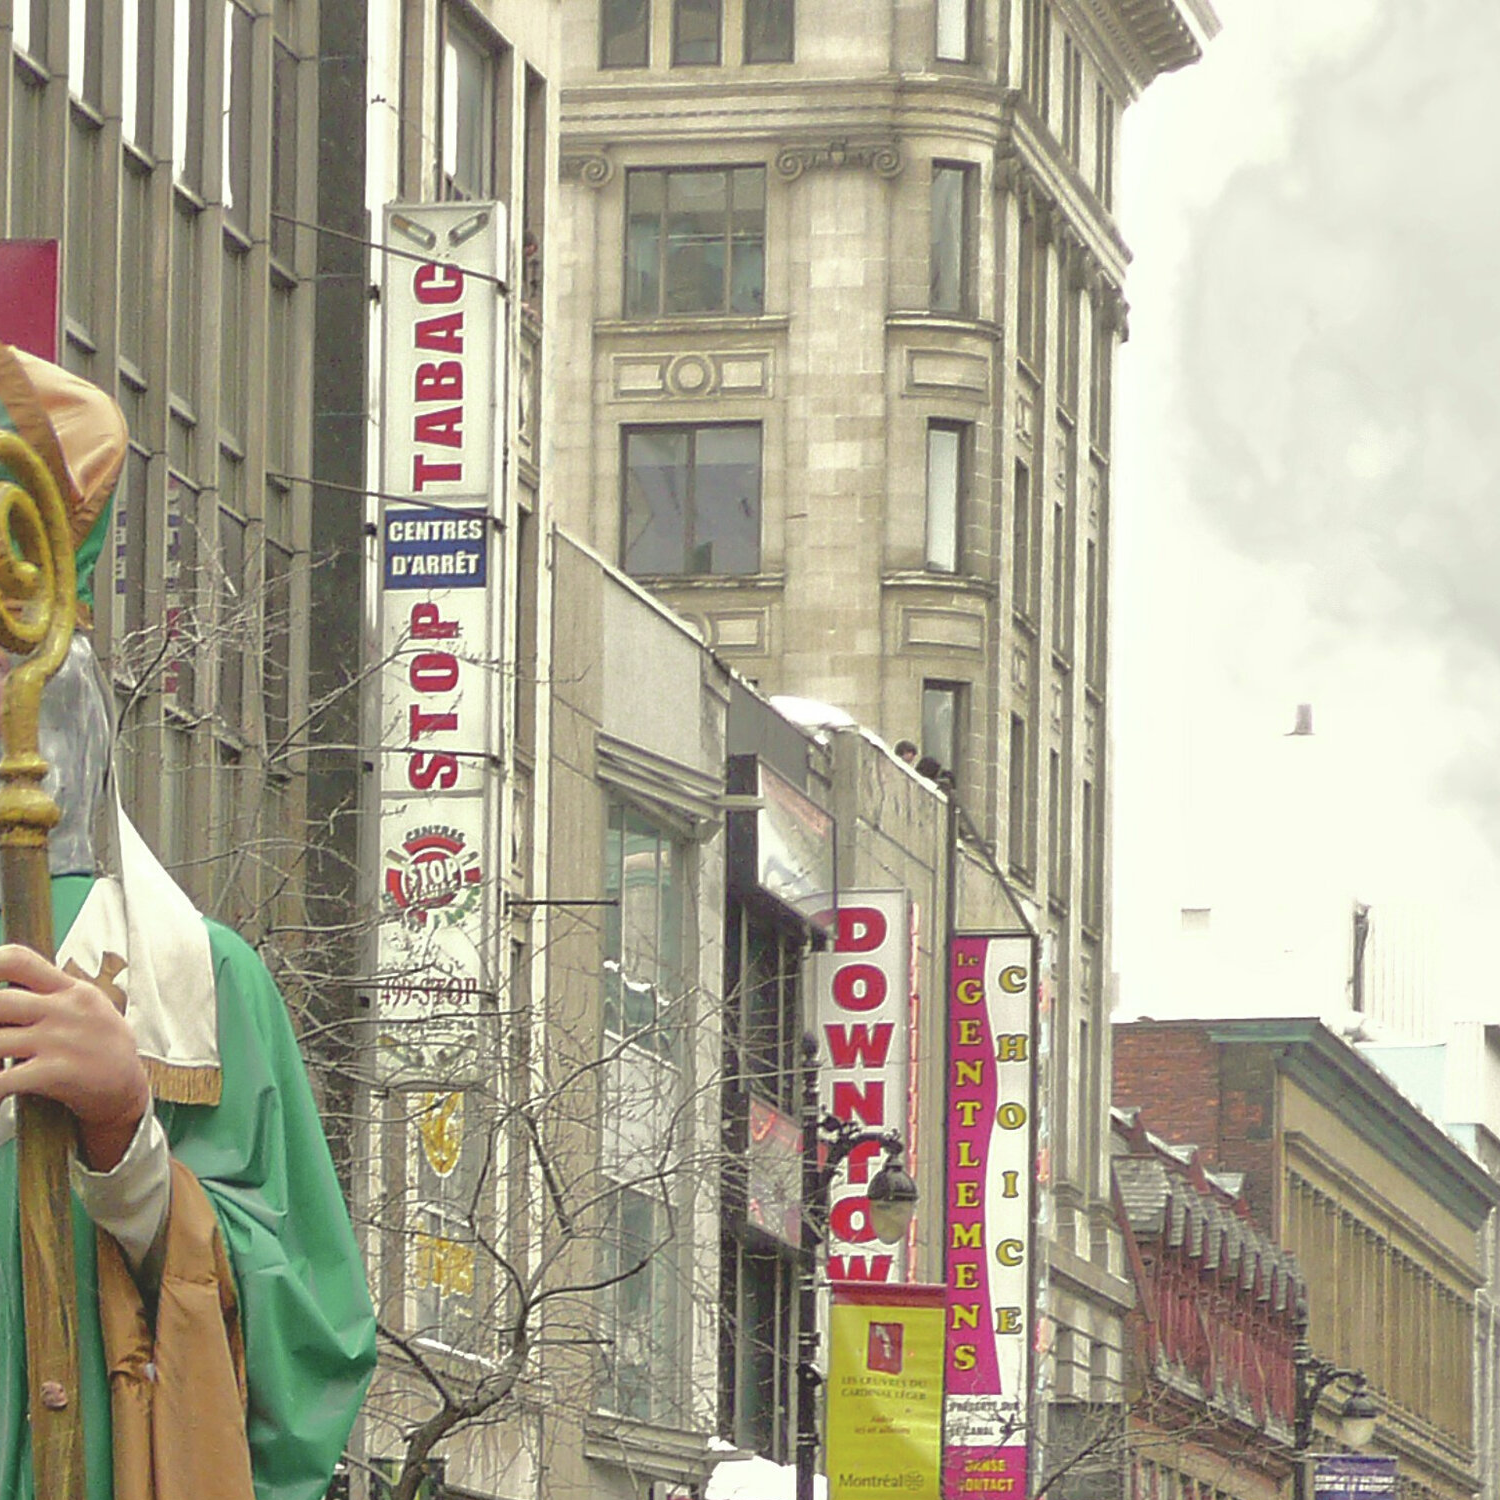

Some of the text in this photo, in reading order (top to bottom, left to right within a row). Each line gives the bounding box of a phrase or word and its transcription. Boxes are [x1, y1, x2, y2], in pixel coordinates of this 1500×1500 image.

[412, 261, 465, 492] TABAC
[389, 520, 484, 542] CENTRES
[391, 550, 480, 576] D'ARRÊT
[407, 600, 460, 790] STOP
[409, 859, 457, 893] STOP
[956, 952, 980, 968] Le
[995, 965, 1030, 1335] CHOICE
[951, 978, 984, 1371] GENTLEMENS
[838, 1473, 904, 1488] Montréal
